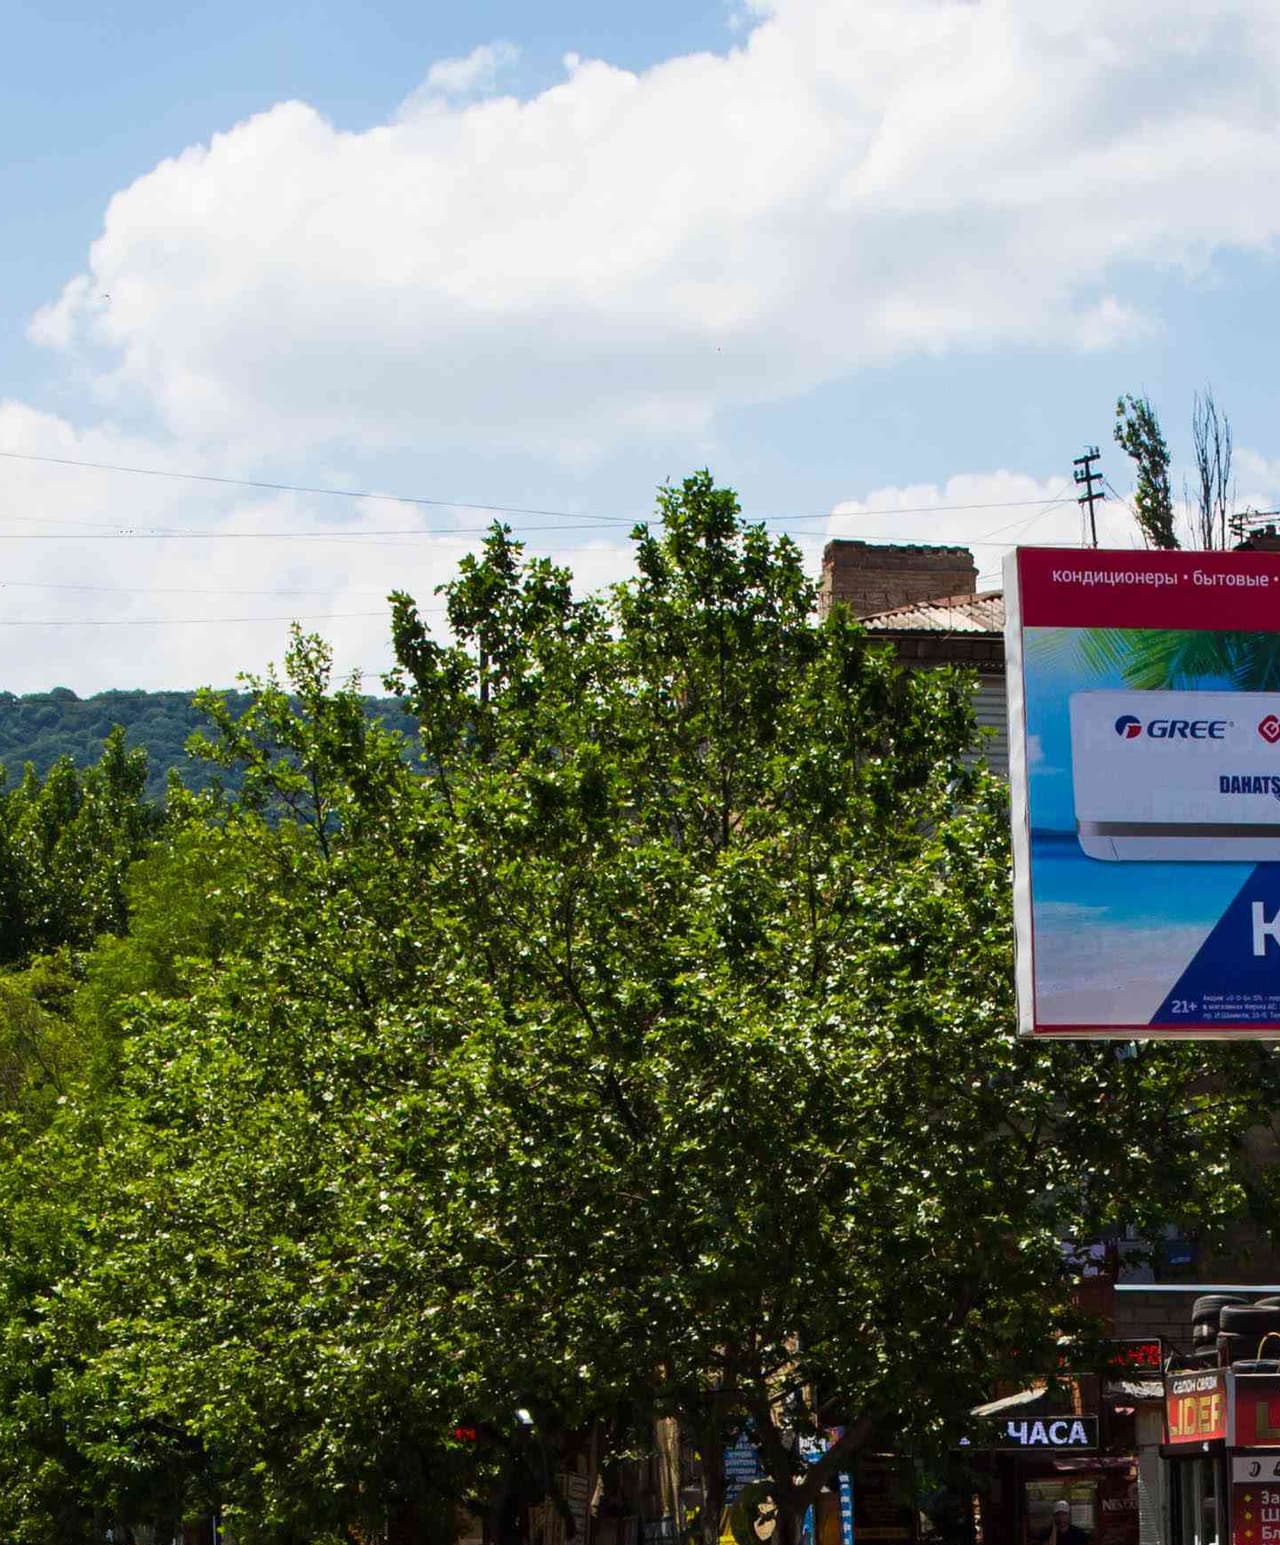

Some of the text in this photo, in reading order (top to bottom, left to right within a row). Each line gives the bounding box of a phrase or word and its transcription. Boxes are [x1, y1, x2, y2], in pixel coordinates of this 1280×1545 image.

[1052, 568, 1178, 587] кондиционеры
[1193, 570, 1269, 588] бытовые
[1147, 719, 1225, 741] GREE
[1171, 1000, 1198, 1014] 21+
[1007, 1420, 1088, 1445] ЧАСА
